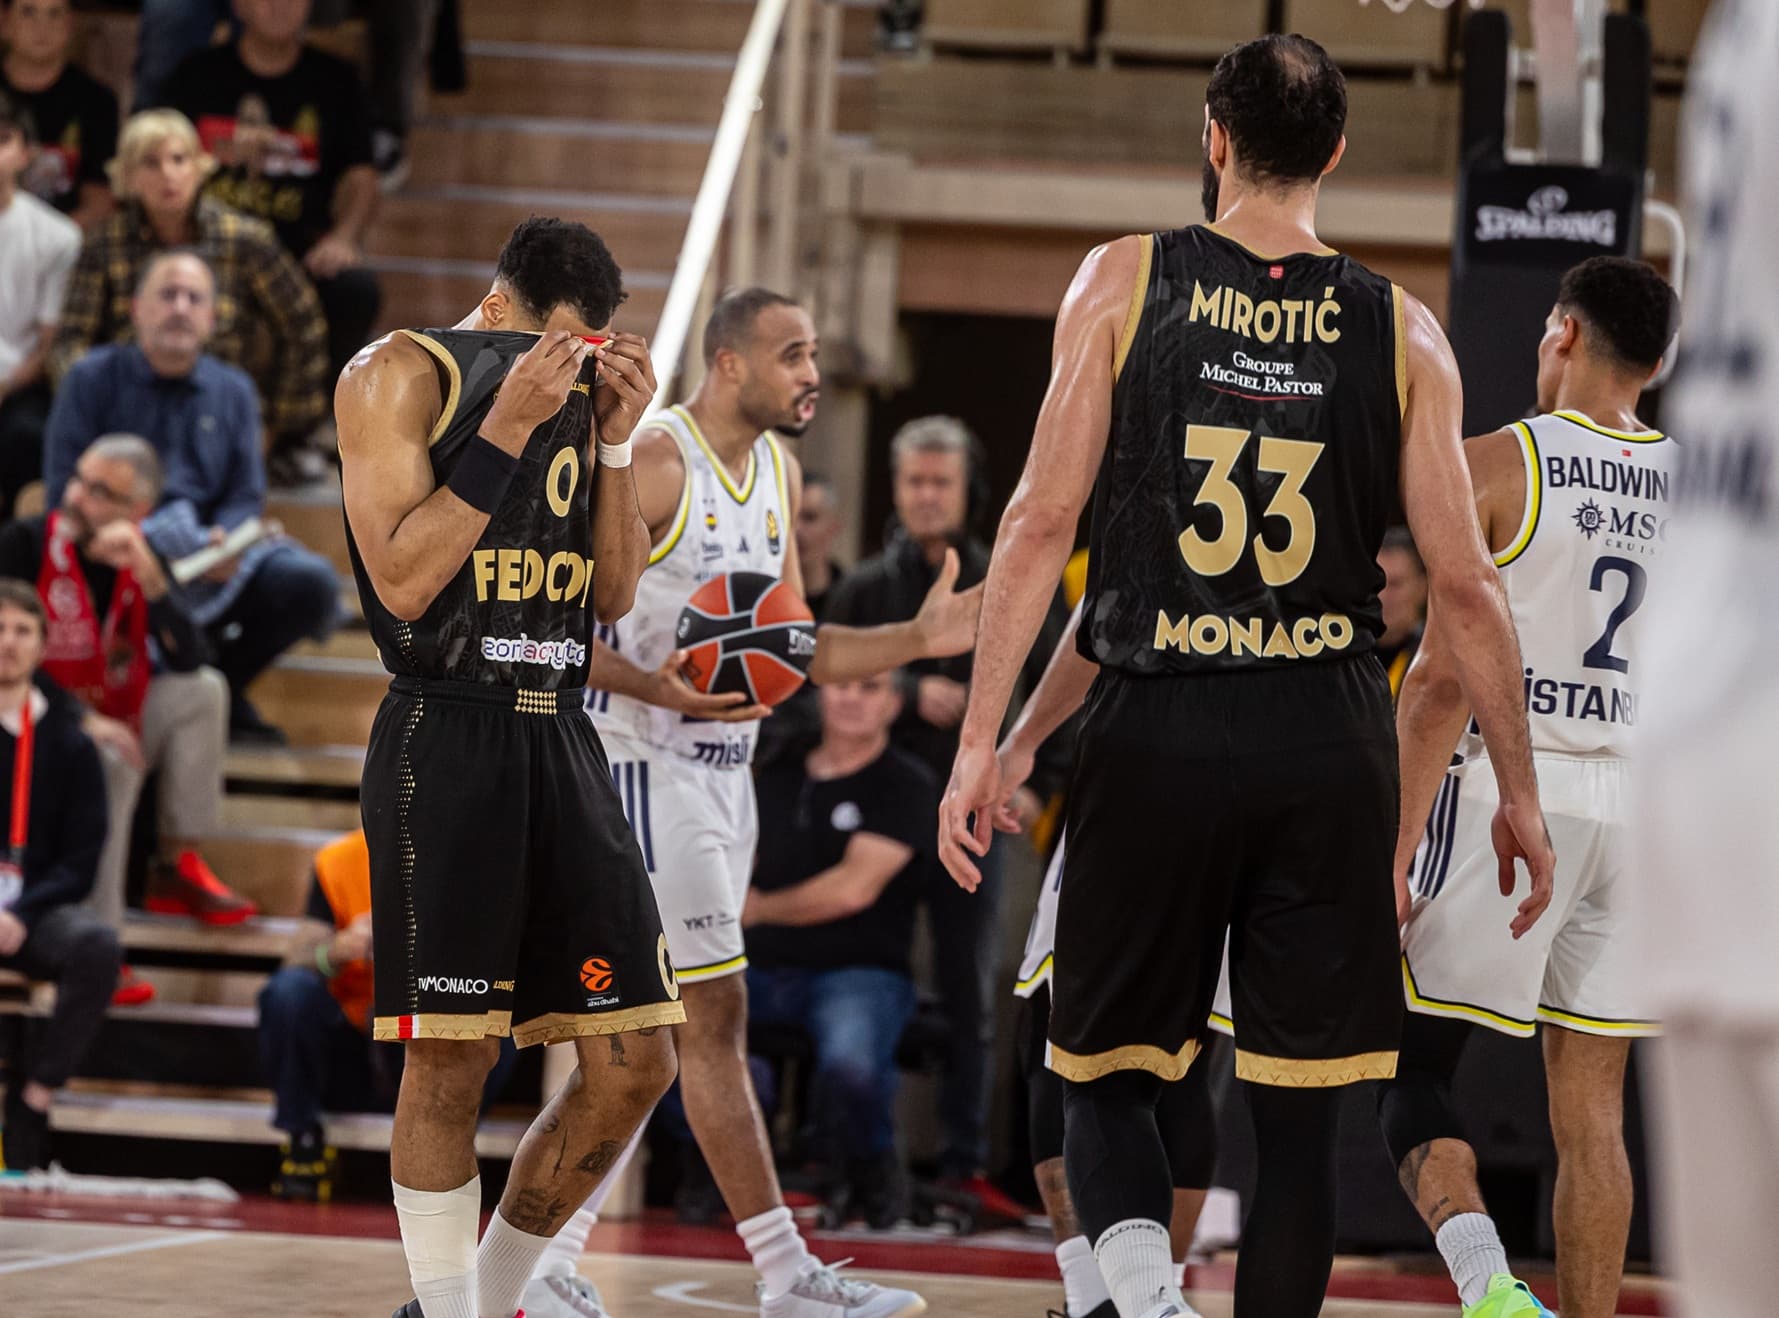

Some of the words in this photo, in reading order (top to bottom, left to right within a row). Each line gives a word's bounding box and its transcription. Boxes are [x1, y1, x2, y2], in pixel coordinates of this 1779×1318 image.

[1475, 205, 1616, 246] SPALDING
[1189, 279, 1342, 343] MIROTIĆ
[1178, 424, 1326, 586] 33
[1546, 456, 1669, 502] BALDWIN
[1153, 608, 1354, 658] MONACO
[1582, 556, 1648, 674] 2
